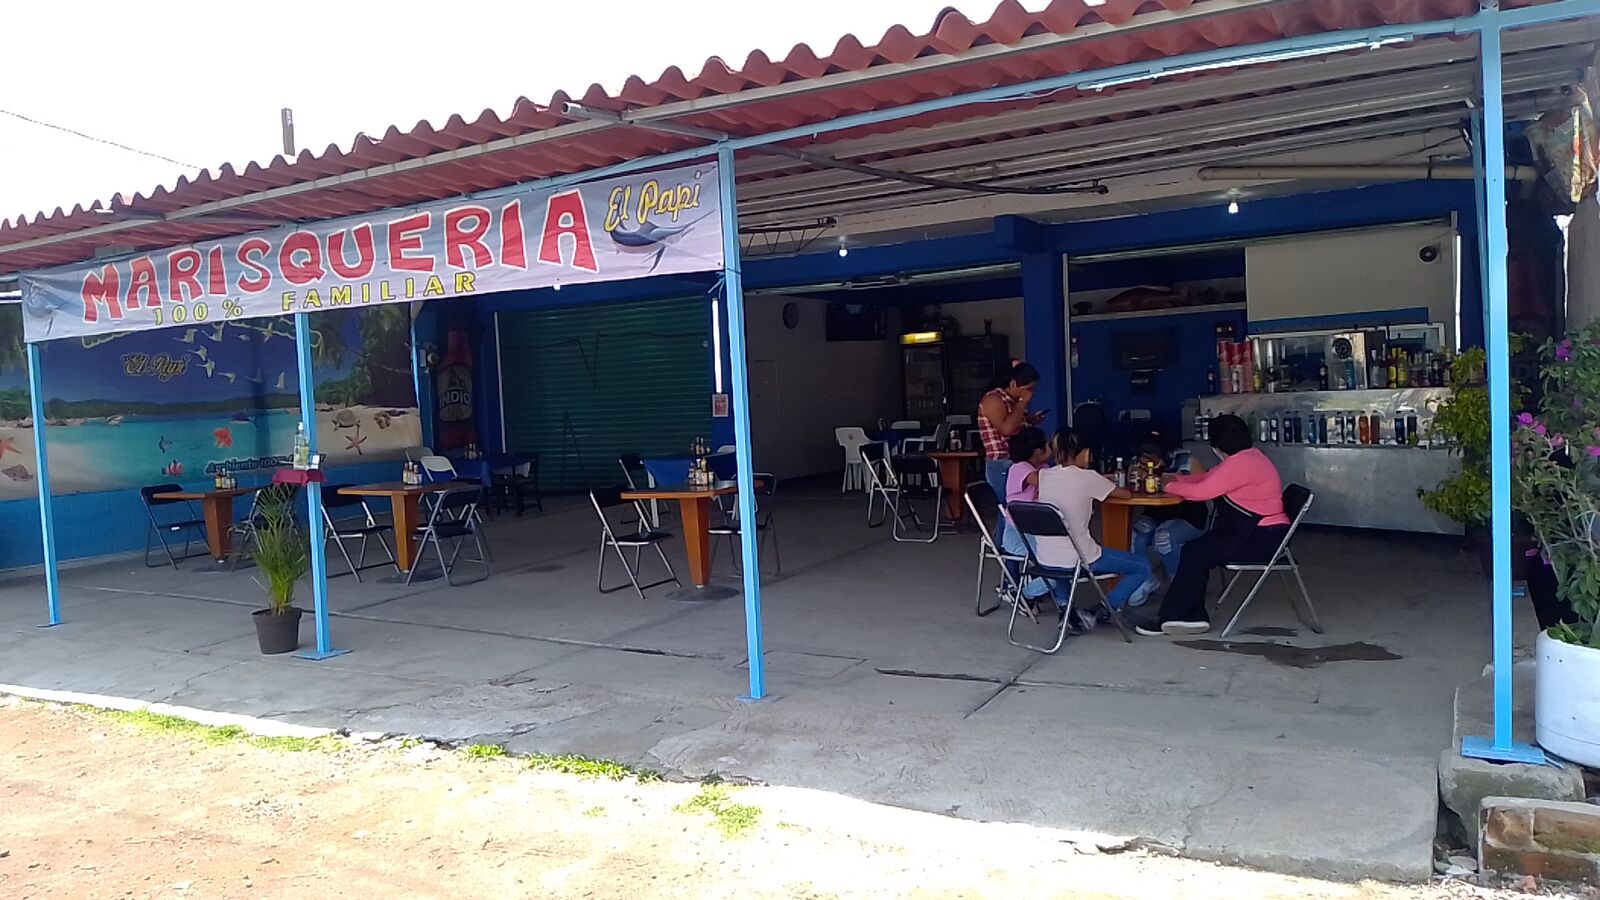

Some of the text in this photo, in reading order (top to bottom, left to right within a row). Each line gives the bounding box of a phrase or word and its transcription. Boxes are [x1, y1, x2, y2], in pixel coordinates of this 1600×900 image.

[603, 170, 702, 232] El Papi
[80, 188, 599, 323] MARISQUERIA
[281, 271, 477, 312] FAMILIAR
[439, 390, 470, 408] INDIO
